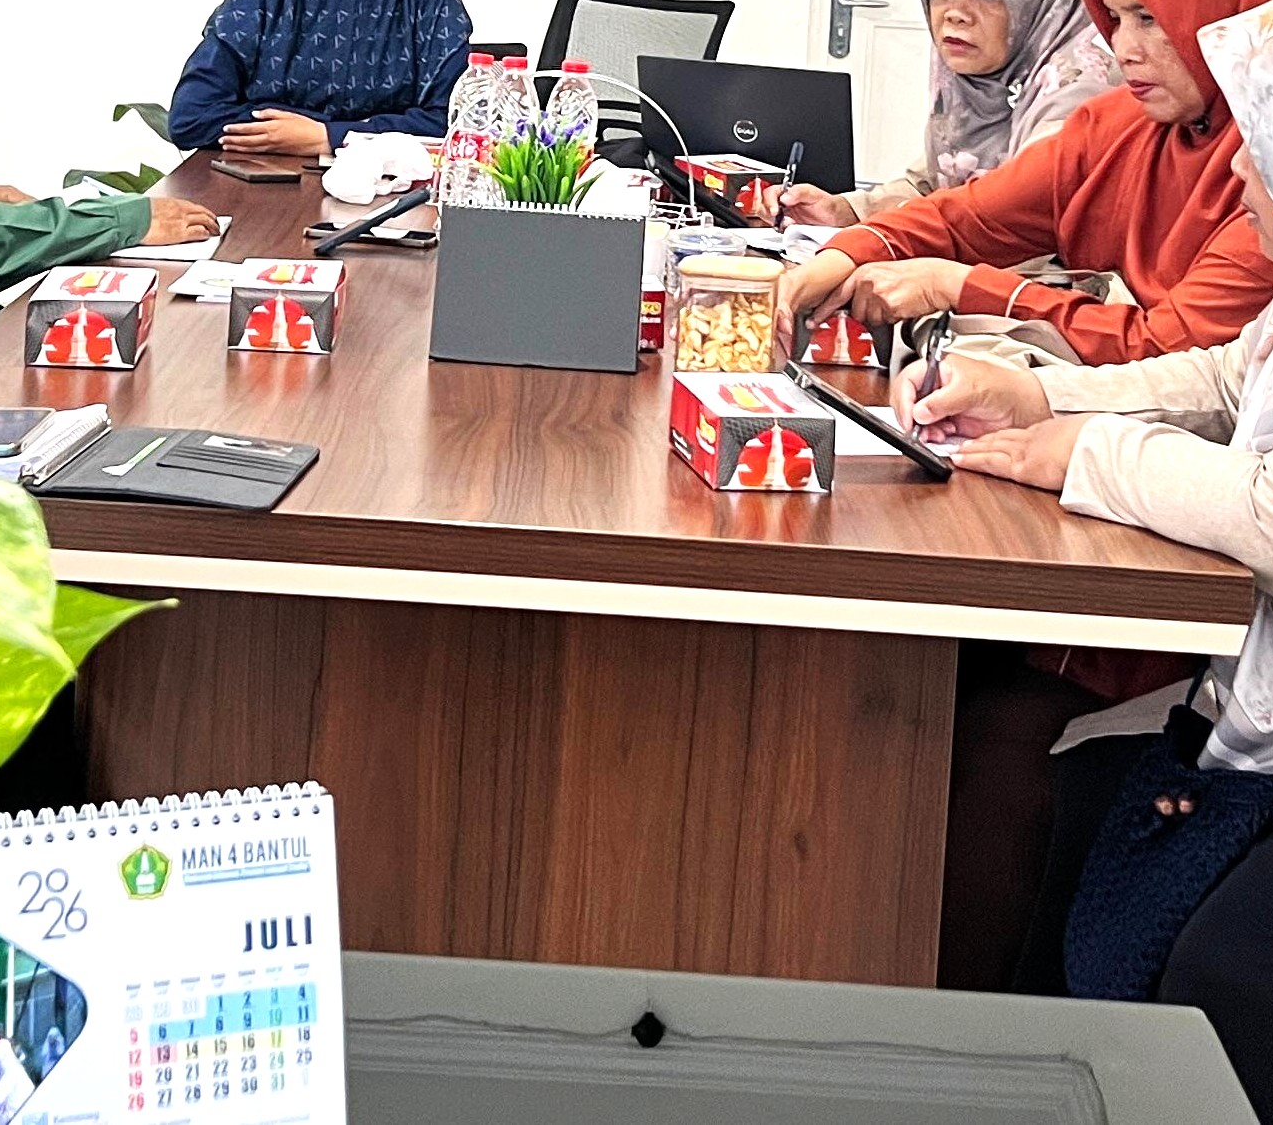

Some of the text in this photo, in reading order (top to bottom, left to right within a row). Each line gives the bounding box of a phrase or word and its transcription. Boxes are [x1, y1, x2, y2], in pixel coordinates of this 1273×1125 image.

[182, 835, 312, 871] MAN 4 BANTUL
[242, 913, 312, 953] JULI
[243, 990, 252, 1009] 2
[297, 983, 306, 1001] 4
[158, 1024, 167, 1042] 6
[187, 1019, 195, 1038] 7
[243, 1012, 252, 1031] 9
[298, 1004, 309, 1024] 11
[128, 1048, 142, 1067] 12
[156, 1044, 171, 1063] 13
[185, 1041, 199, 1060] 14
[213, 1037, 228, 1056] 15
[241, 1033, 256, 1052] 16
[156, 1067, 173, 1086] 20
[185, 1063, 200, 1082] 21
[212, 1059, 229, 1078] 22
[240, 1055, 257, 1073] 23
[269, 1051, 285, 1070] 24
[296, 1048, 313, 1065] 25
[128, 1092, 145, 1111] 26
[157, 1088, 173, 1108] 27
[213, 1080, 230, 1100] 29
[241, 1077, 258, 1095] 30
[271, 1073, 285, 1092] 31
